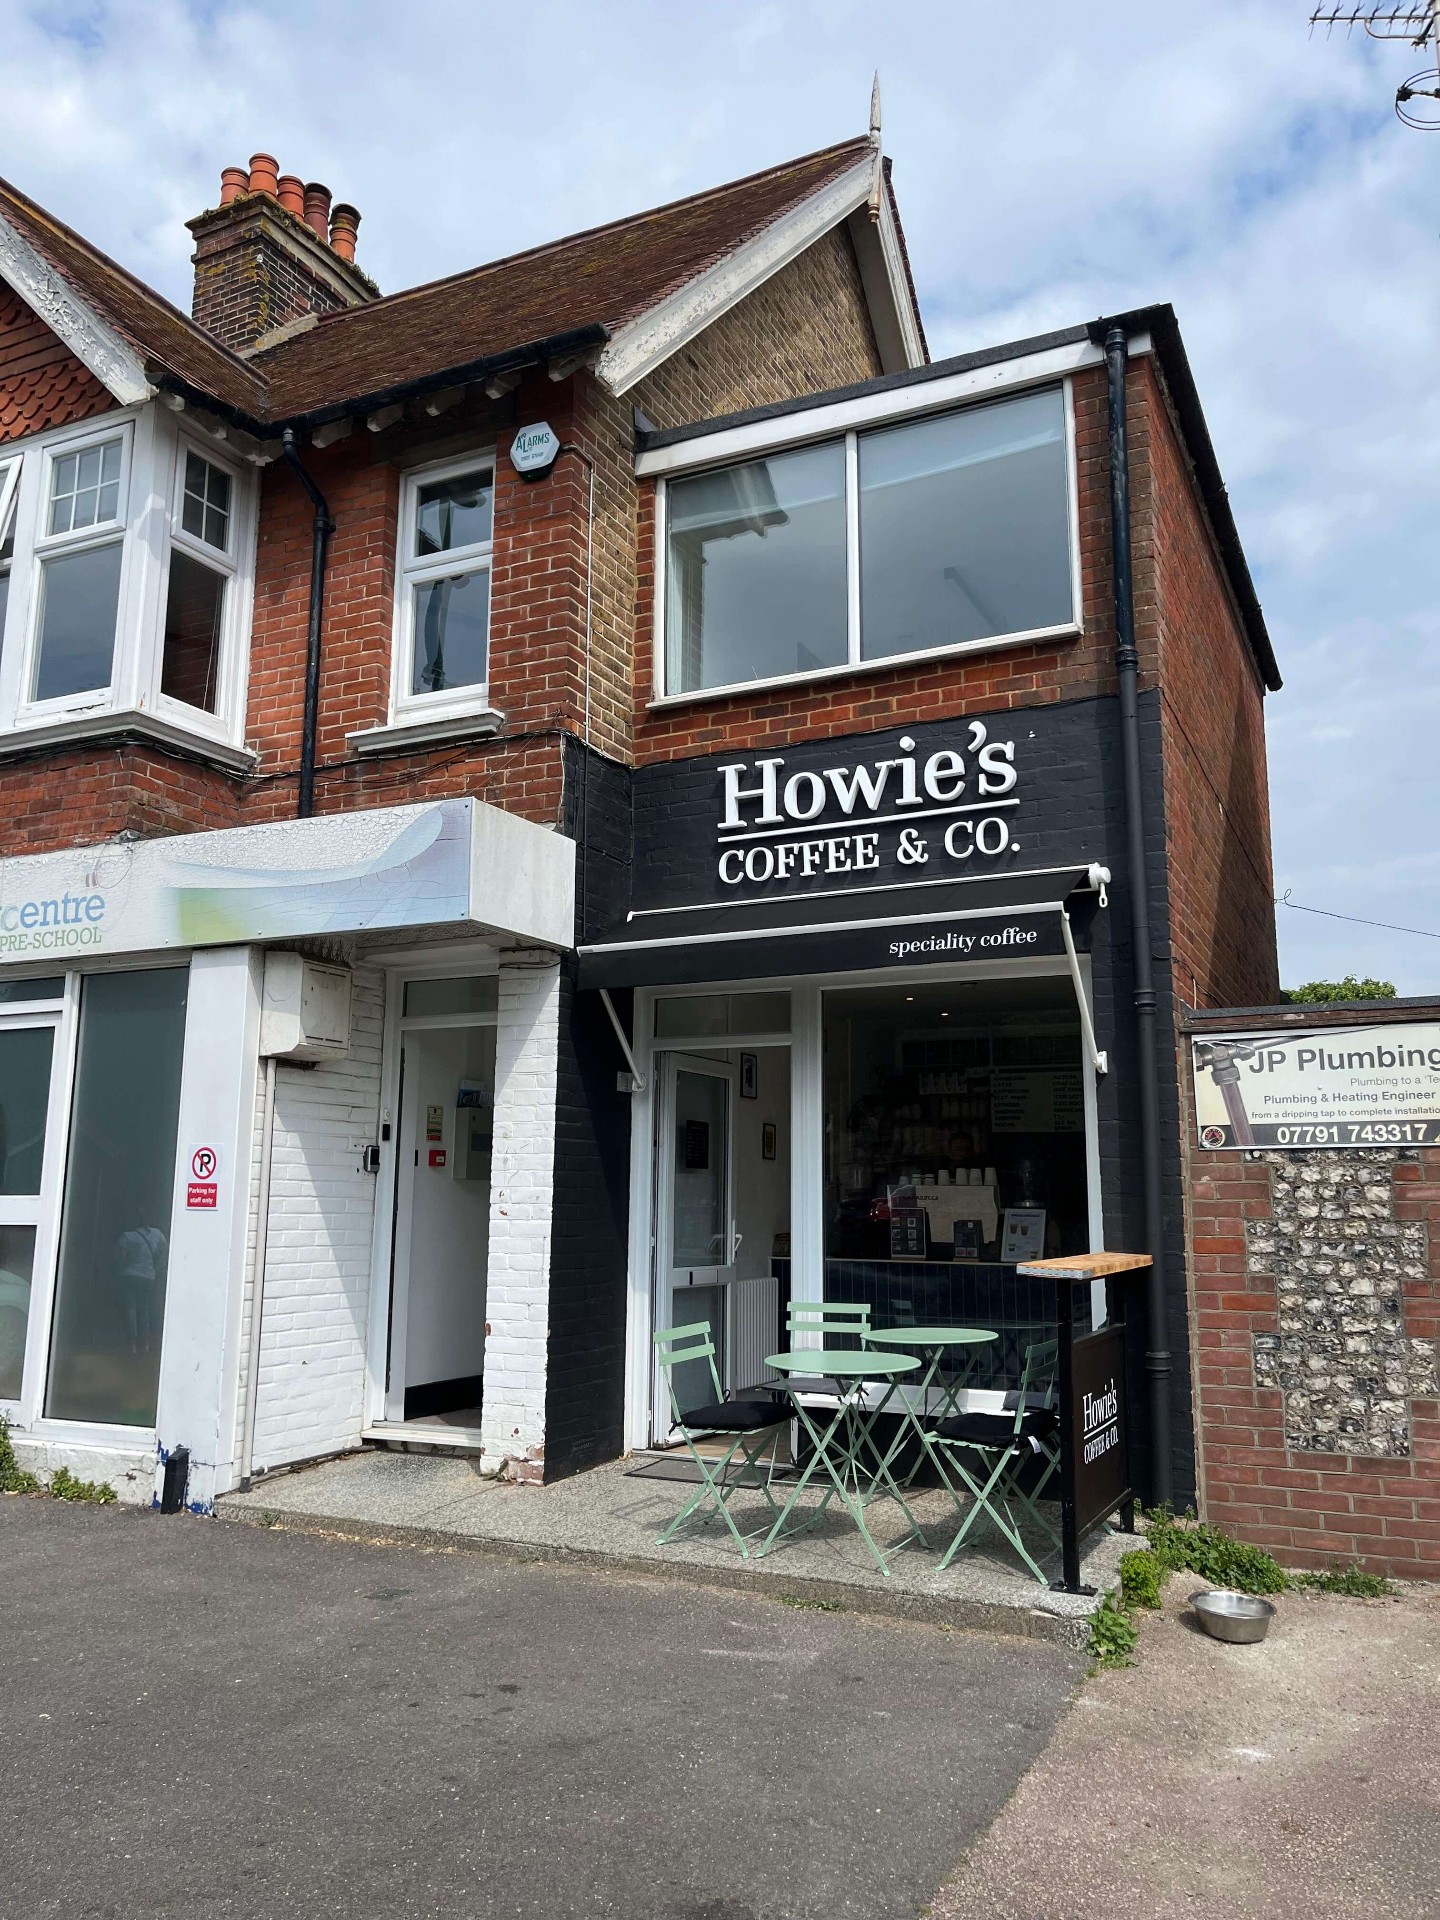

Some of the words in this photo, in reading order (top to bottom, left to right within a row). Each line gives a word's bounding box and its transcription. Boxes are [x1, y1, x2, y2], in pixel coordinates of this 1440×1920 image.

[717, 720, 1018, 830] Howie's
[718, 833, 880, 885] COFFEE
[897, 828, 929, 865] &
[944, 817, 1021, 859] CO.
[0, 891, 106, 932] centre
[889, 932, 976, 958] speciality
[980, 926, 1038, 947] coffee
[1249, 1049, 1287, 1074] JP
[1298, 1044, 1440, 1073] Plumbing
[1350, 1076, 1398, 1087] Plumbing
[1401, 1076, 1412, 1085] to
[1424, 1074, 1440, 1084] 'Te
[1251, 1111, 1272, 1119] from
[1281, 1110, 1319, 1119] dripping
[1320, 1110, 1336, 1118] tap
[1338, 1109, 1347, 1117] to
[1349, 1107, 1393, 1117] complete
[1264, 1094, 1318, 1105] Plumbing
[1320, 1093, 1329, 1103] &
[1332, 1092, 1378, 1103] Heating
[1382, 1090, 1437, 1102] Engineer
[1277, 1125, 1339, 1144] 07791
[1347, 1123, 1428, 1143] 743317
[189, 1187, 208, 1195] Parking
[1082, 1377, 1118, 1432] Howie's
[1084, 1433, 1106, 1465] COFFEE
[1105, 1431, 1111, 1450] &
